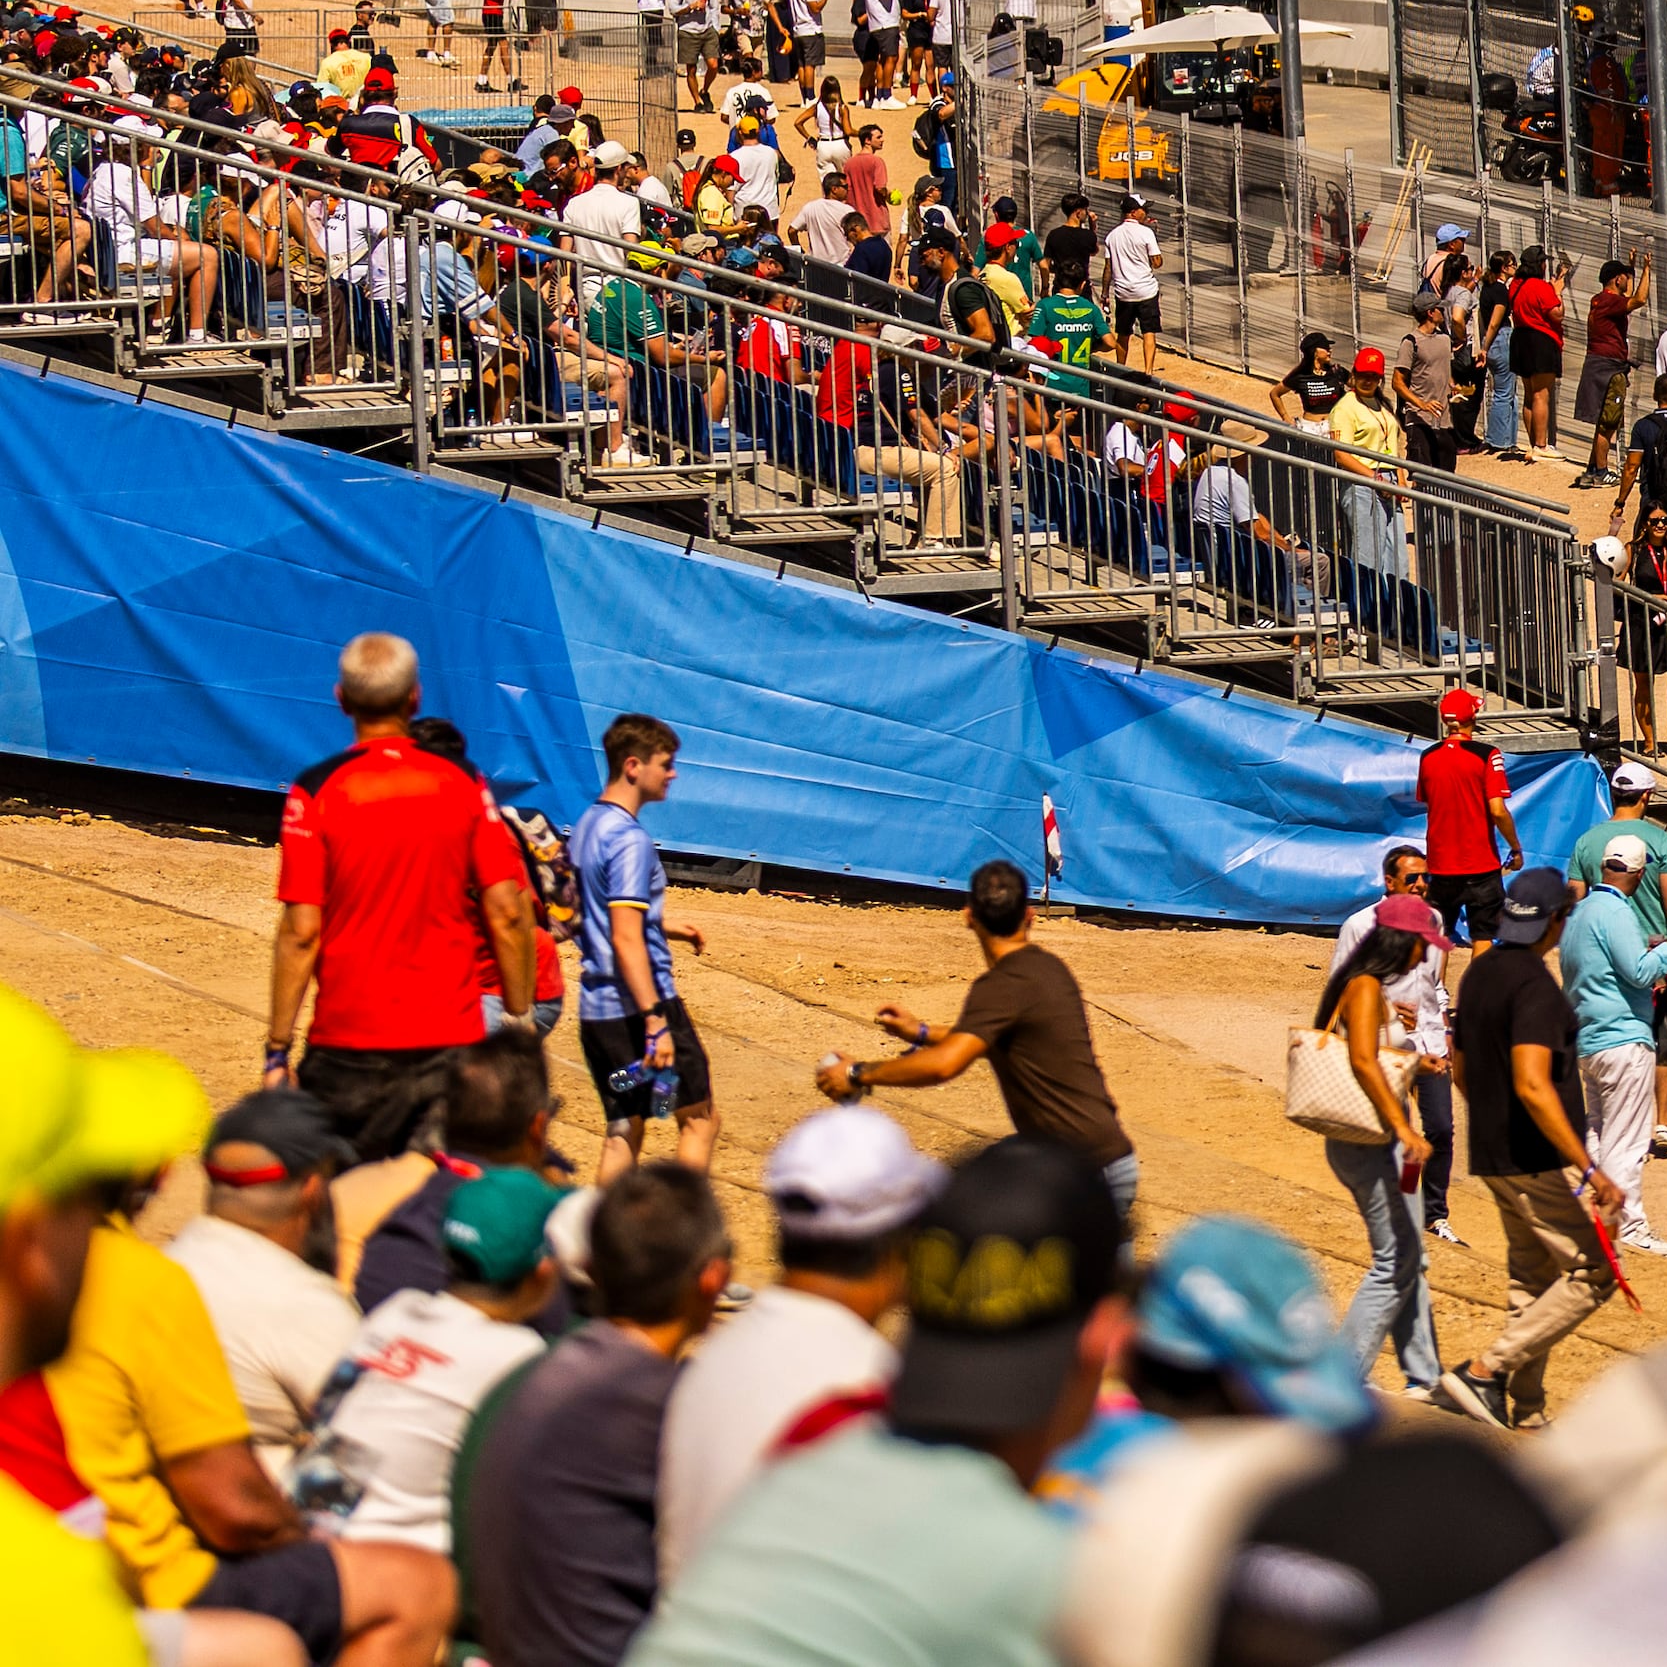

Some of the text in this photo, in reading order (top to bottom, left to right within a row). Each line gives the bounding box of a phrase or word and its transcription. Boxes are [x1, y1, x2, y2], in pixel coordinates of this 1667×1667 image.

[1110, 151, 1154, 162] JCB
[1055, 323, 1092, 332] aramco
[1058, 337, 1091, 364] 14
